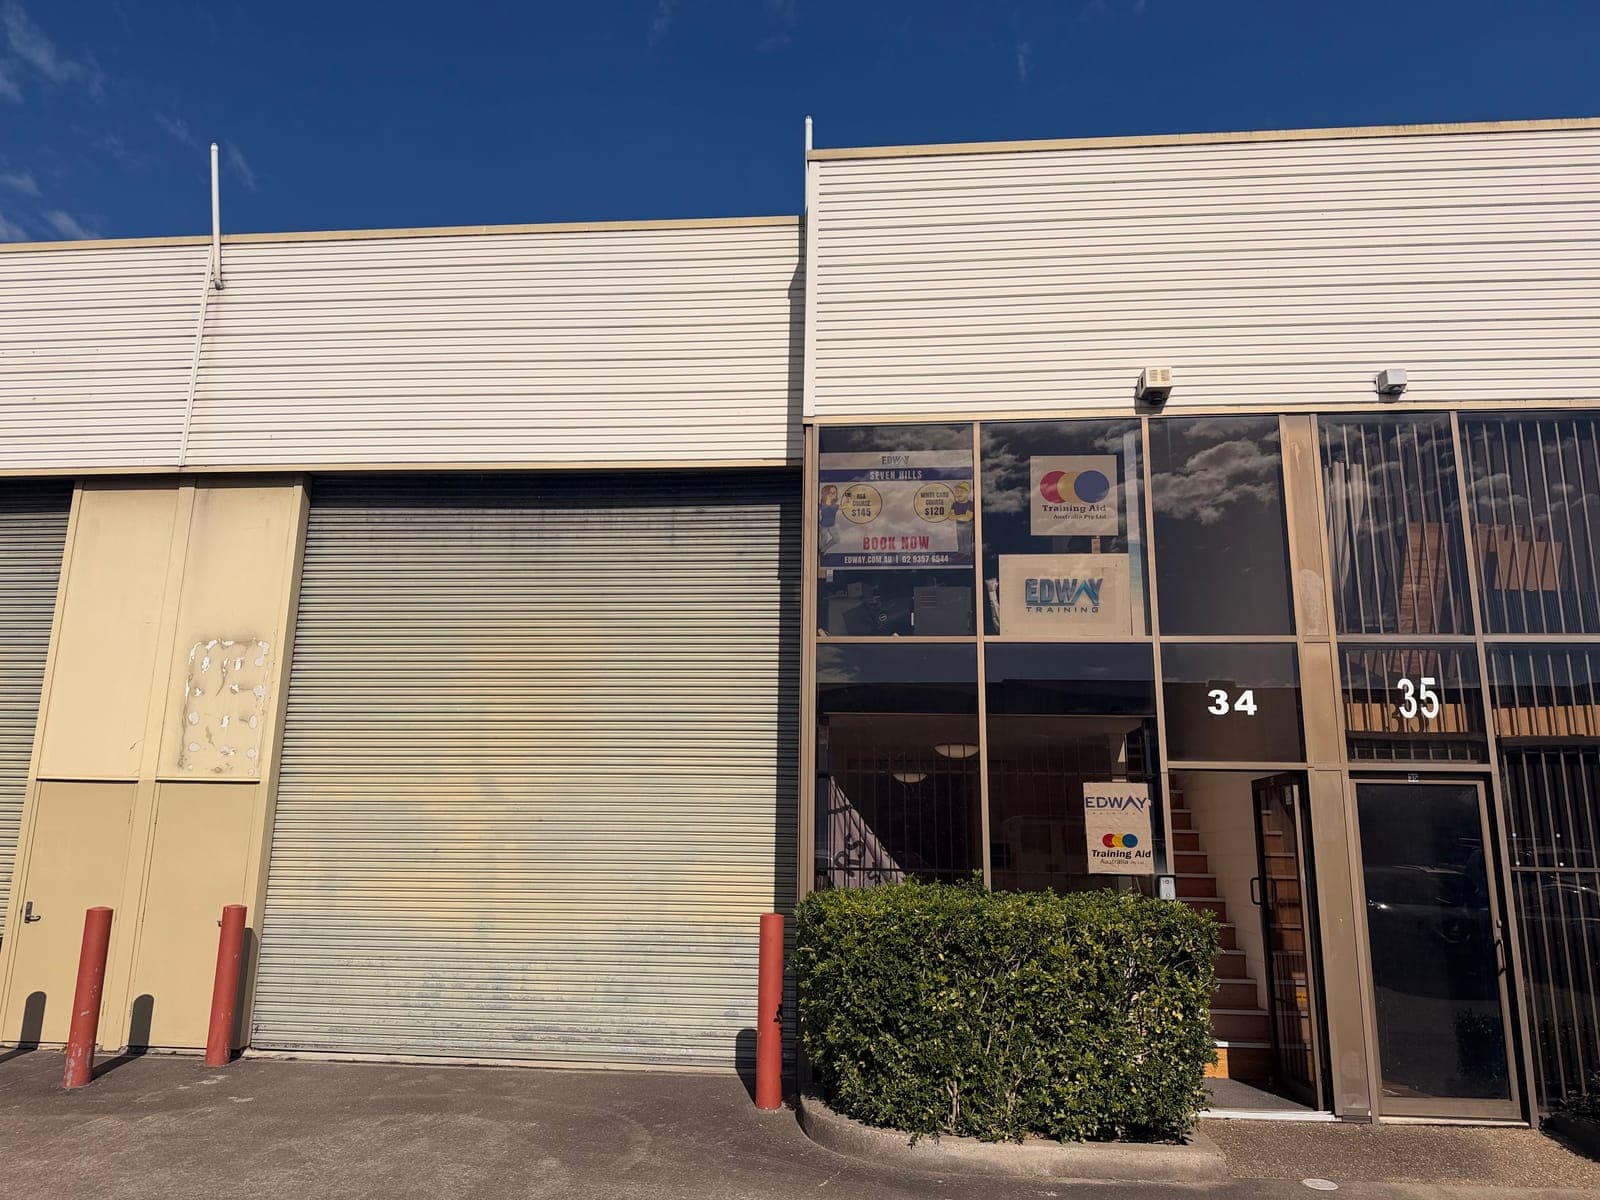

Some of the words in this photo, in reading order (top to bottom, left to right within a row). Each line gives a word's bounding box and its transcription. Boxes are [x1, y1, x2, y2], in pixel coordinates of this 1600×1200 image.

[881, 455, 910, 465] EDWAY
[869, 471, 896, 480] SEVEN
[899, 470, 923, 480] HILLS
[851, 507, 872, 517] $145
[924, 506, 945, 516] $120
[1042, 505, 1087, 513] Training
[1088, 504, 1107, 512] Aid
[863, 537, 896, 550] BOOK
[901, 535, 930, 549] NOW
[844, 556, 893, 564] EDWAY.COM.AU
[902, 555, 912, 563] 02
[1025, 578, 1103, 606] EDWAY
[1207, 689, 1258, 716] 34
[1397, 677, 1440, 719] 35
[1084, 795, 1148, 813] EDWAY
[1091, 849, 1132, 859] Training
[1134, 849, 1152, 858] Aid
